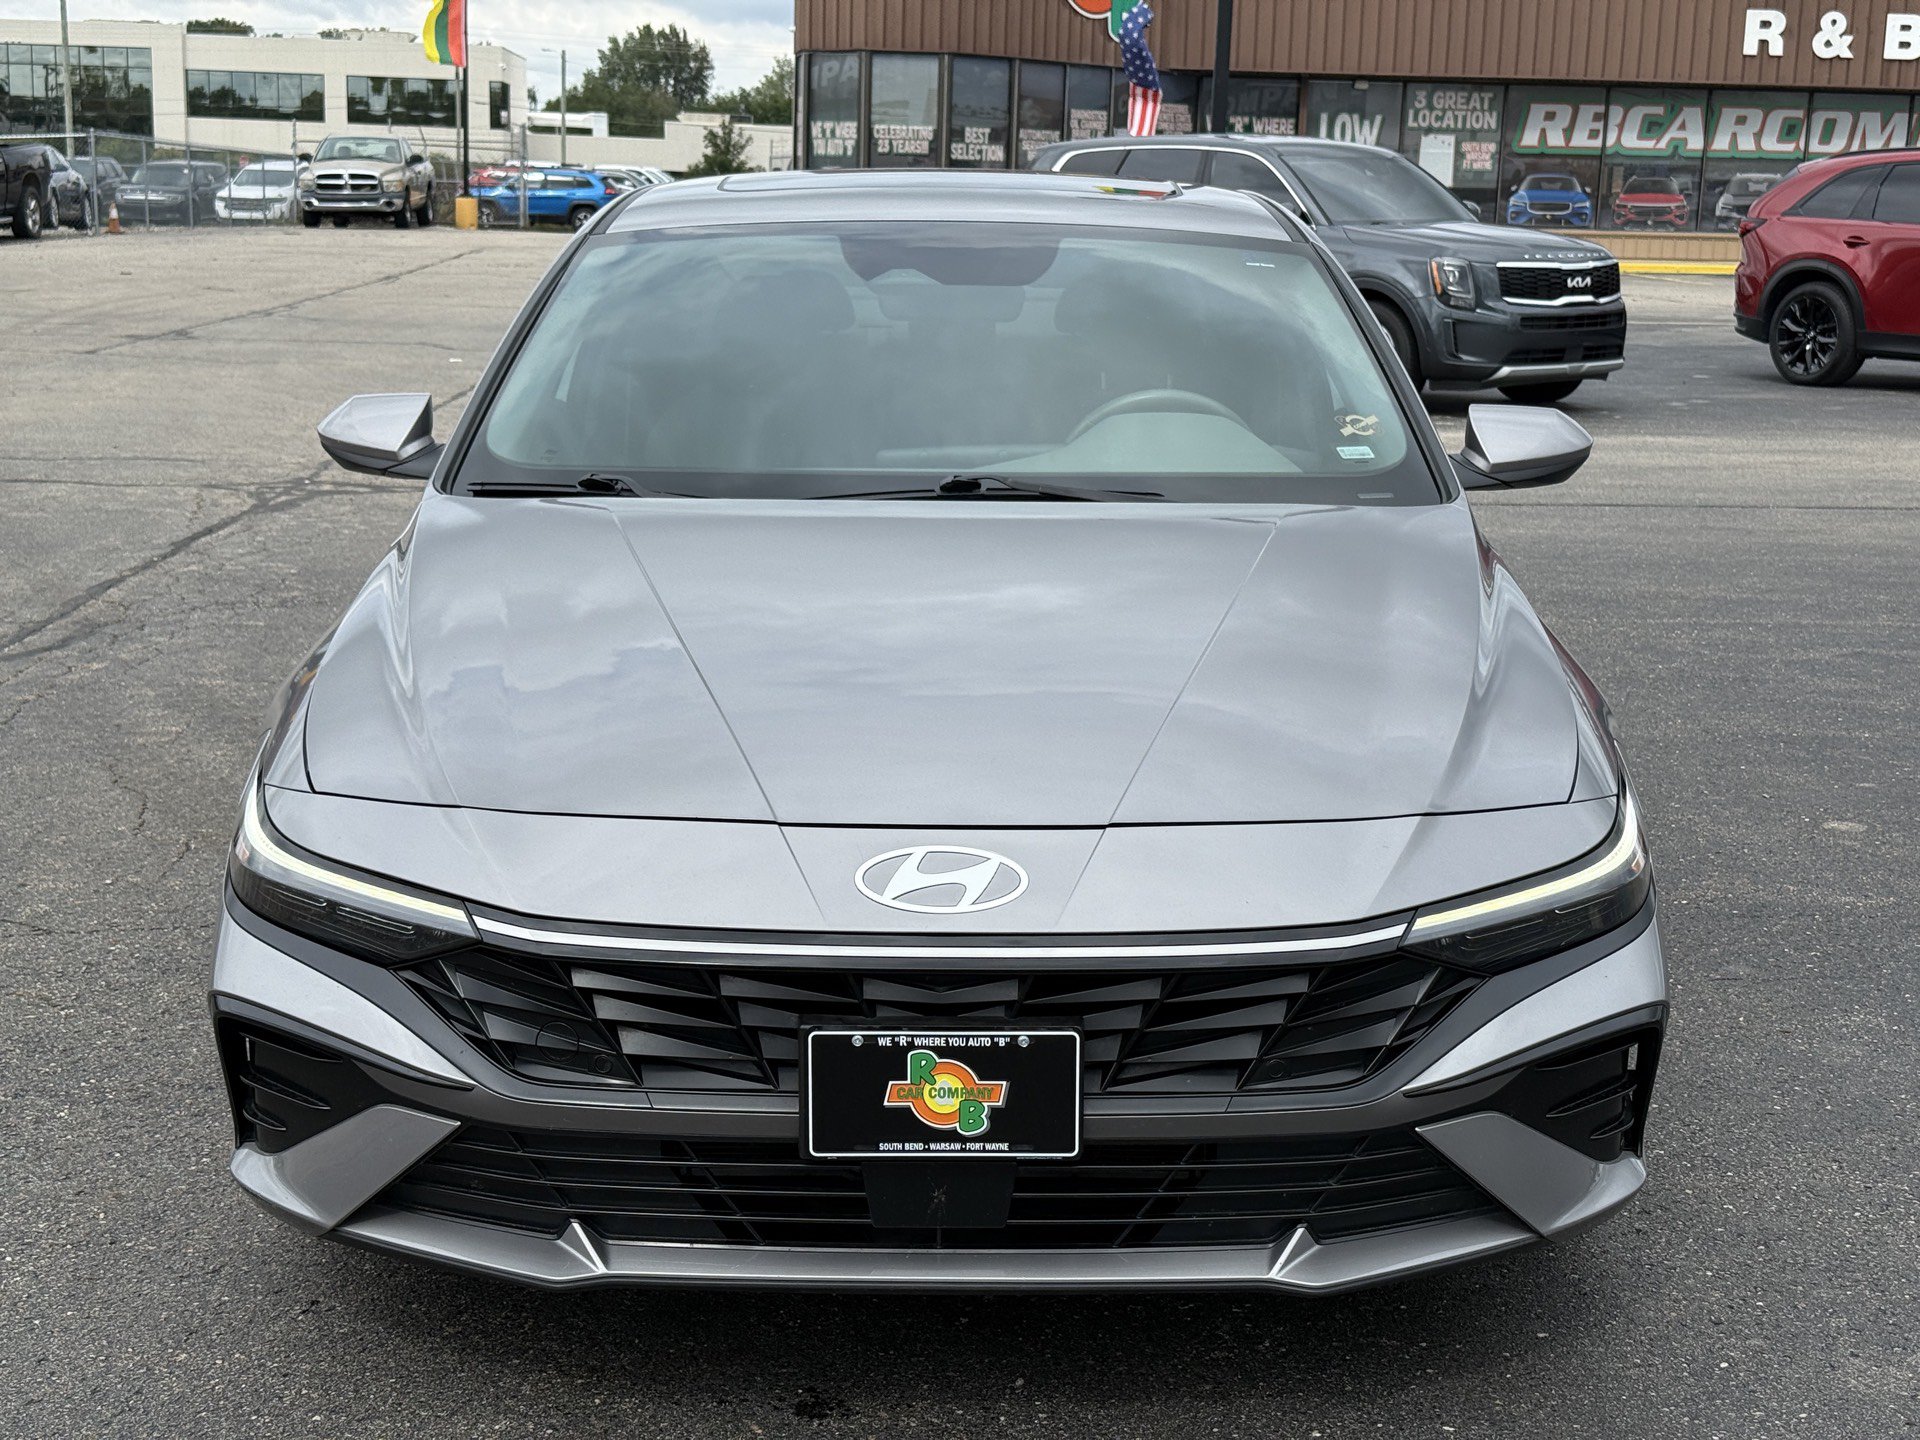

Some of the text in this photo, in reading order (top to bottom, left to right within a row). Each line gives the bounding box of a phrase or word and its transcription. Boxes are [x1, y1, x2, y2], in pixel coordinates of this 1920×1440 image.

[1743, 9, 1920, 60] R & B
[1414, 89, 1494, 110] 3 GREAT
[1252, 116, 1296, 135] WHERE
[1319, 112, 1382, 146] LOW
[1407, 109, 1498, 130] LOCATION
[1519, 103, 1920, 152] RBCARCOM
[873, 124, 934, 140] CELEBRATING
[964, 126, 991, 144] BEST
[950, 142, 1004, 162] SELECTION
[877, 1036, 1011, 1047] WE "R" WHERE YOU AUTO "B"
[910, 1051, 937, 1085] R
[896, 1086, 994, 1099] CAR COMPANY
[959, 1100, 986, 1133] B
[879, 1142, 1009, 1151] SOUTH BEND WARSAW FORT WAYNE
